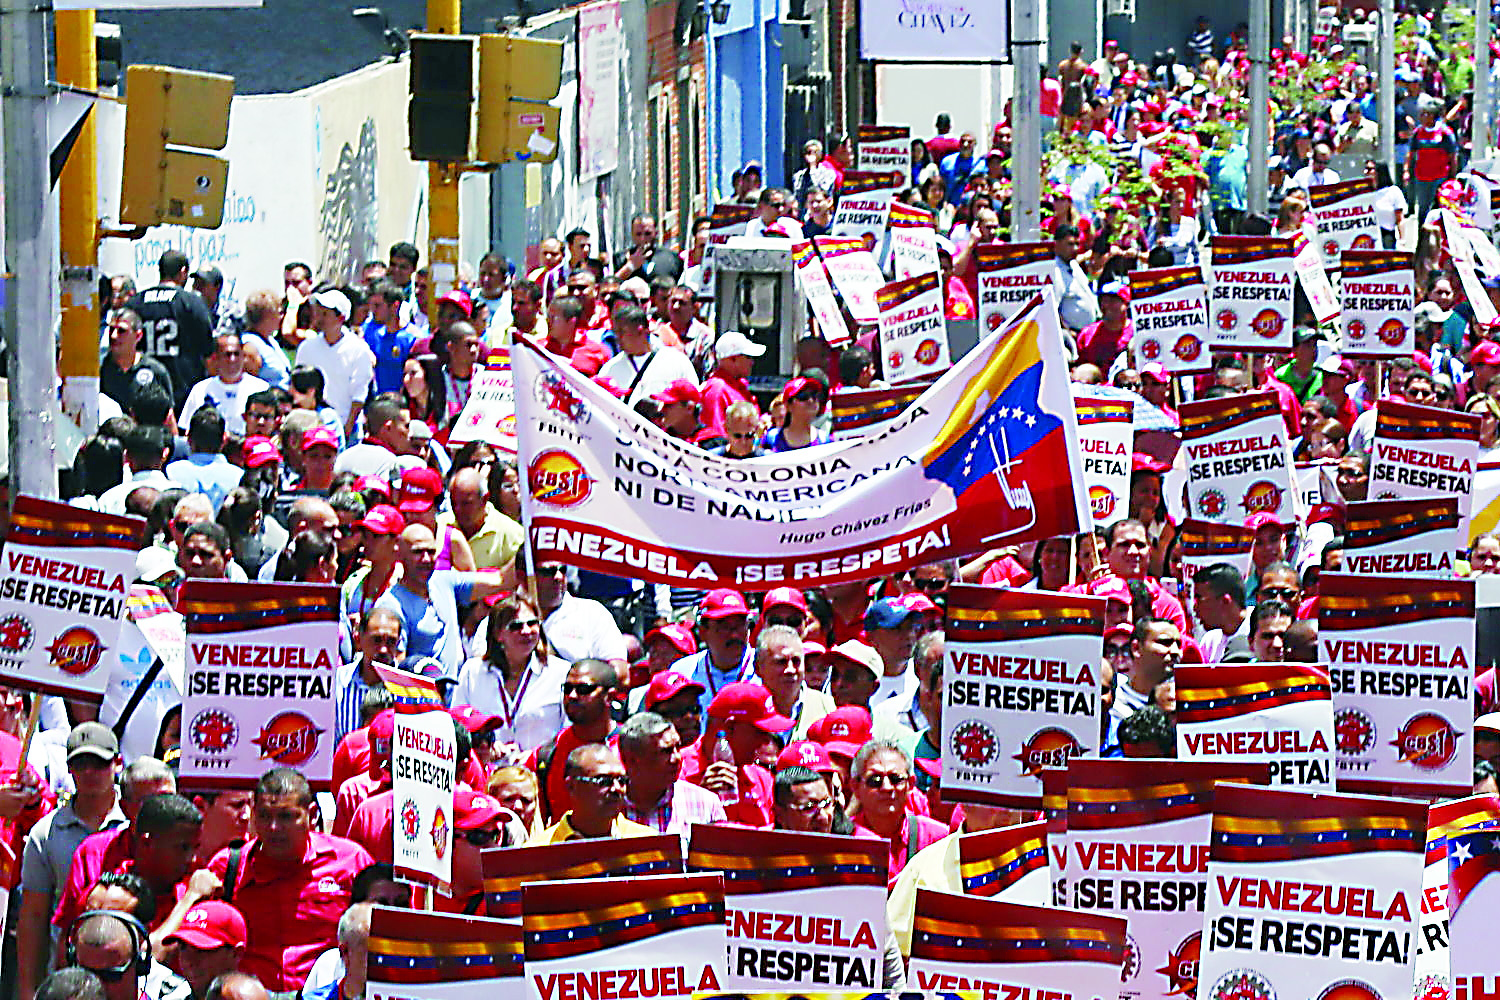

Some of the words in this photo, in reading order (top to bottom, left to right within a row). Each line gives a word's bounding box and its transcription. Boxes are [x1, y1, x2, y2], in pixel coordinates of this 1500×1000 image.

[1314, 205, 1375, 221] VENEZUELA
[983, 274, 1053, 287] VENEZUELA
[1214, 271, 1291, 285] VENEZUELA
[1344, 283, 1412, 296] VENEZUELA
[1134, 299, 1203, 315] VENEZUELA
[1213, 287, 1231, 300] ¡SE
[1232, 286, 1288, 301] RESPETA!
[1359, 299, 1412, 312] RESPETA!
[883, 305, 940, 327] VENEZUELA
[143, 318, 180, 357] 12
[1188, 434, 1283, 461] VENEZUELA
[1377, 445, 1473, 475] VENEZUELA
[702, 455, 851, 483] COLONIA
[1189, 462, 1212, 483] ¡SE
[1213, 449, 1285, 478] RESPETA!
[1373, 464, 1399, 482] ¡SE
[1397, 467, 1471, 495] RESPETA!
[614, 476, 642, 499] NI
[653, 487, 695, 512] DE
[780, 531, 825, 545] Hugo
[831, 514, 889, 537] Chávez
[736, 564, 785, 584] ¡SE
[794, 524, 950, 579] RESPETA!
[1348, 551, 1452, 574] VENEZUELA
[8, 551, 126, 595] VENEZUELA
[190, 643, 333, 671] VENEZUELA
[950, 651, 1096, 685] VENEZUELA
[1323, 639, 1469, 669] VENEZUELA
[188, 673, 232, 697] ¡SE
[235, 673, 332, 701] RESPETA!
[947, 680, 996, 709] ¡SE
[998, 684, 1096, 719] RESPETA!
[397, 724, 455, 764] VENEZUELA
[1183, 731, 1329, 755] VENEZUELA
[1269, 760, 1331, 785] PETA!
[1216, 875, 1412, 923] VENEZUELA
[723, 909, 878, 951] ENEZUELA
[1209, 916, 1255, 952] ¡SE
[1259, 919, 1411, 965] RESPETA!
